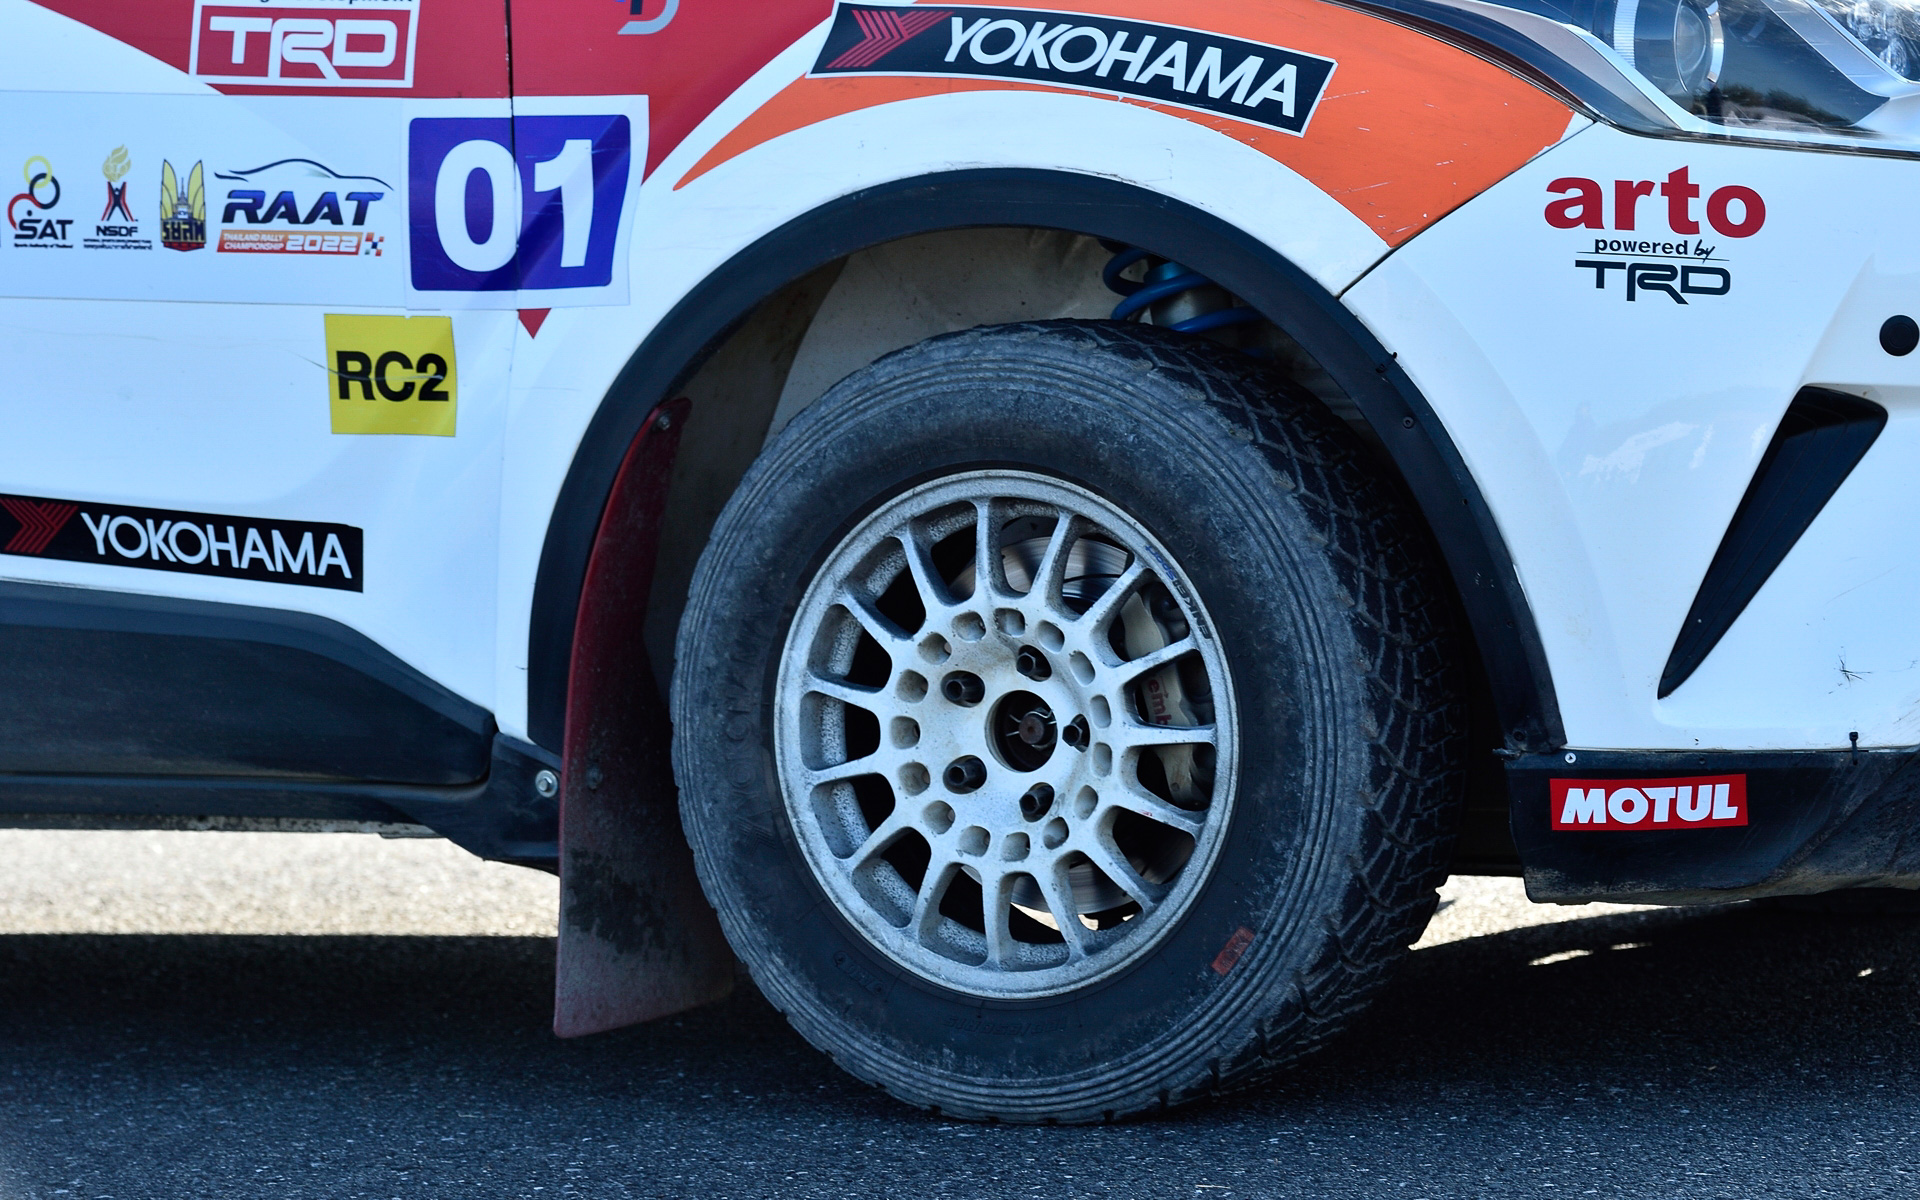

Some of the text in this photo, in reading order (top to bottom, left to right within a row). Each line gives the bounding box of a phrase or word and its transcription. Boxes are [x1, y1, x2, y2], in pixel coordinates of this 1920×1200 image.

[209, 15, 398, 80] TRD
[944, 16, 1298, 118] YOKOHAMA
[221, 189, 385, 226] RAAT
[434, 138, 594, 272] 01
[1544, 165, 1767, 239] arto
[14, 218, 74, 240] SAT
[96, 225, 139, 237] NSDF
[285, 234, 359, 253] 2022
[1593, 238, 1716, 263] powered by
[1575, 259, 1731, 305] TRD
[336, 350, 449, 402] RC2
[79, 511, 353, 579] YOKOHAMA
[1148, 678, 1173, 726] emb
[1560, 783, 1739, 824] MOTUL
